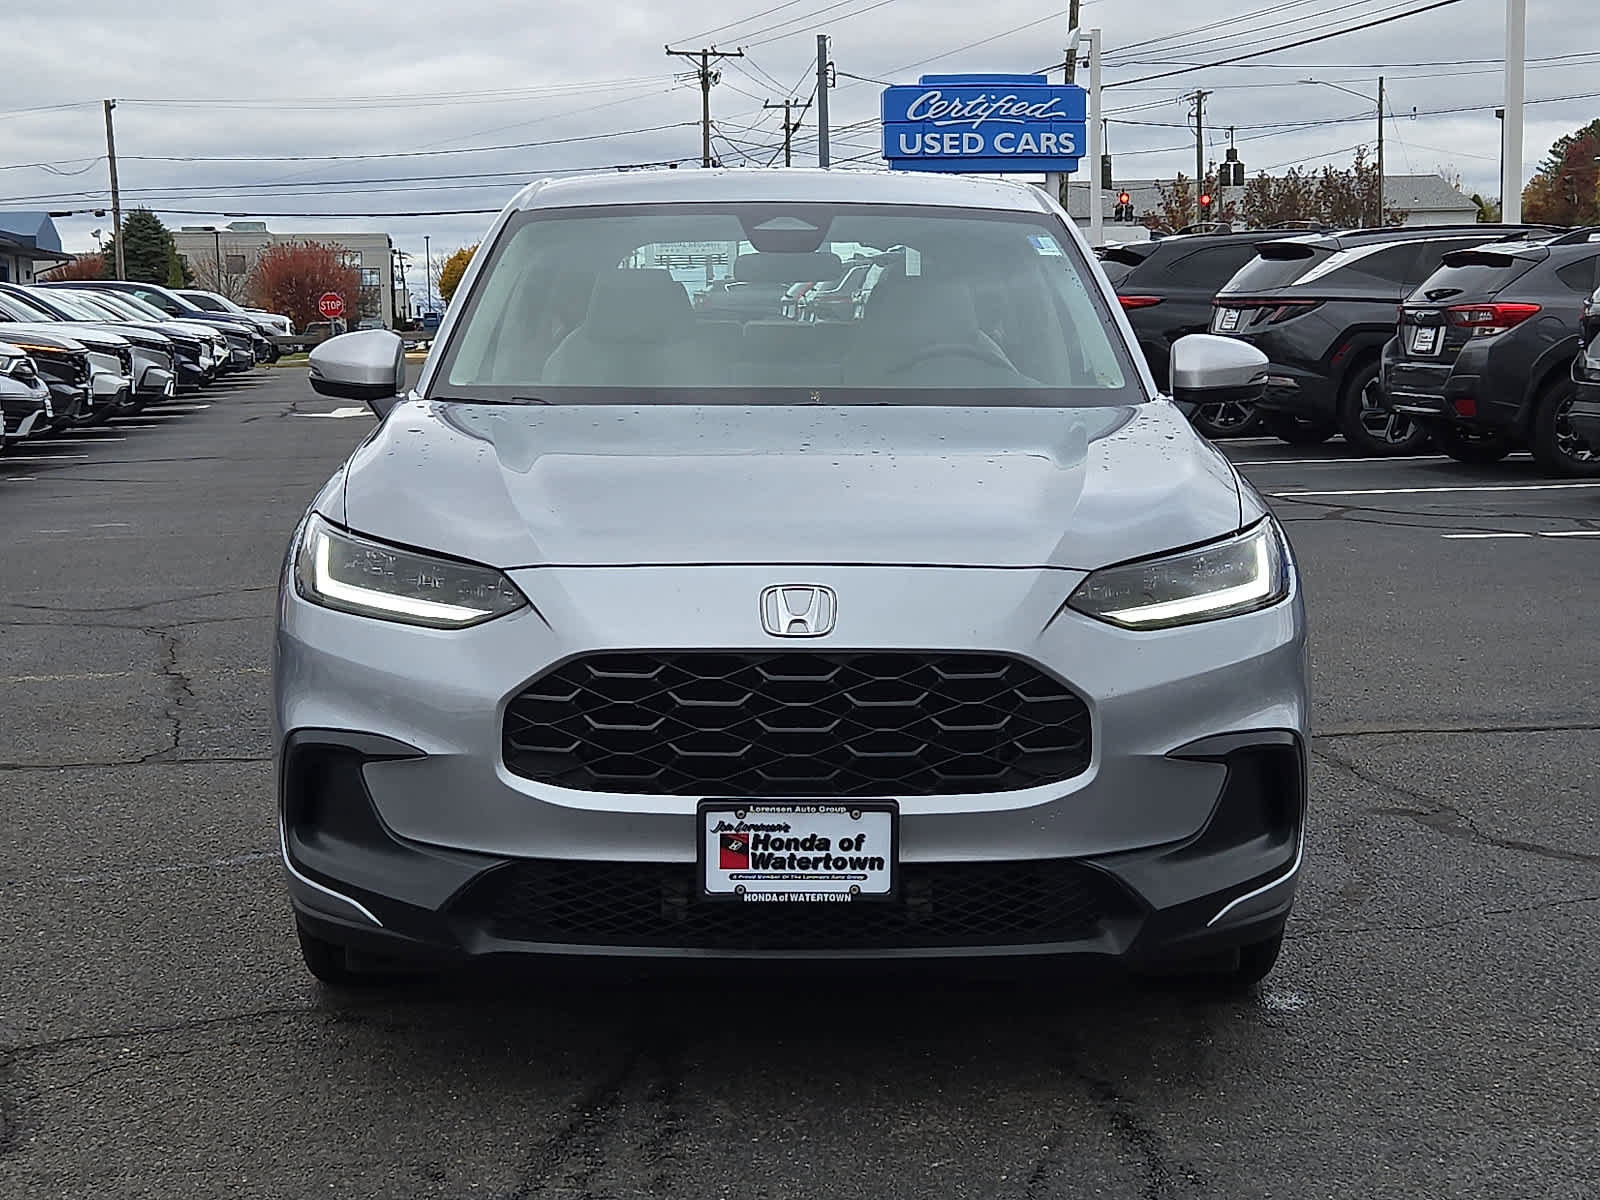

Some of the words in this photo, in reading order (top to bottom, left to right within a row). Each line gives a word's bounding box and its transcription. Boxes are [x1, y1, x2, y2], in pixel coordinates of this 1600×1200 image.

[907, 91, 1066, 129] Certified
[900, 132, 985, 154] USED
[993, 132, 1076, 154] CARS
[320, 300, 342, 311] STOP
[750, 805, 792, 813] Lorensen
[794, 805, 817, 813] Auto
[819, 805, 847, 814] Group
[751, 833, 831, 852] Honda
[838, 833, 867, 852] of
[751, 852, 885, 871] Watertown
[743, 893, 778, 902] HONDA
[778, 893, 789, 902] of
[789, 893, 851, 902] WATERTOWN
